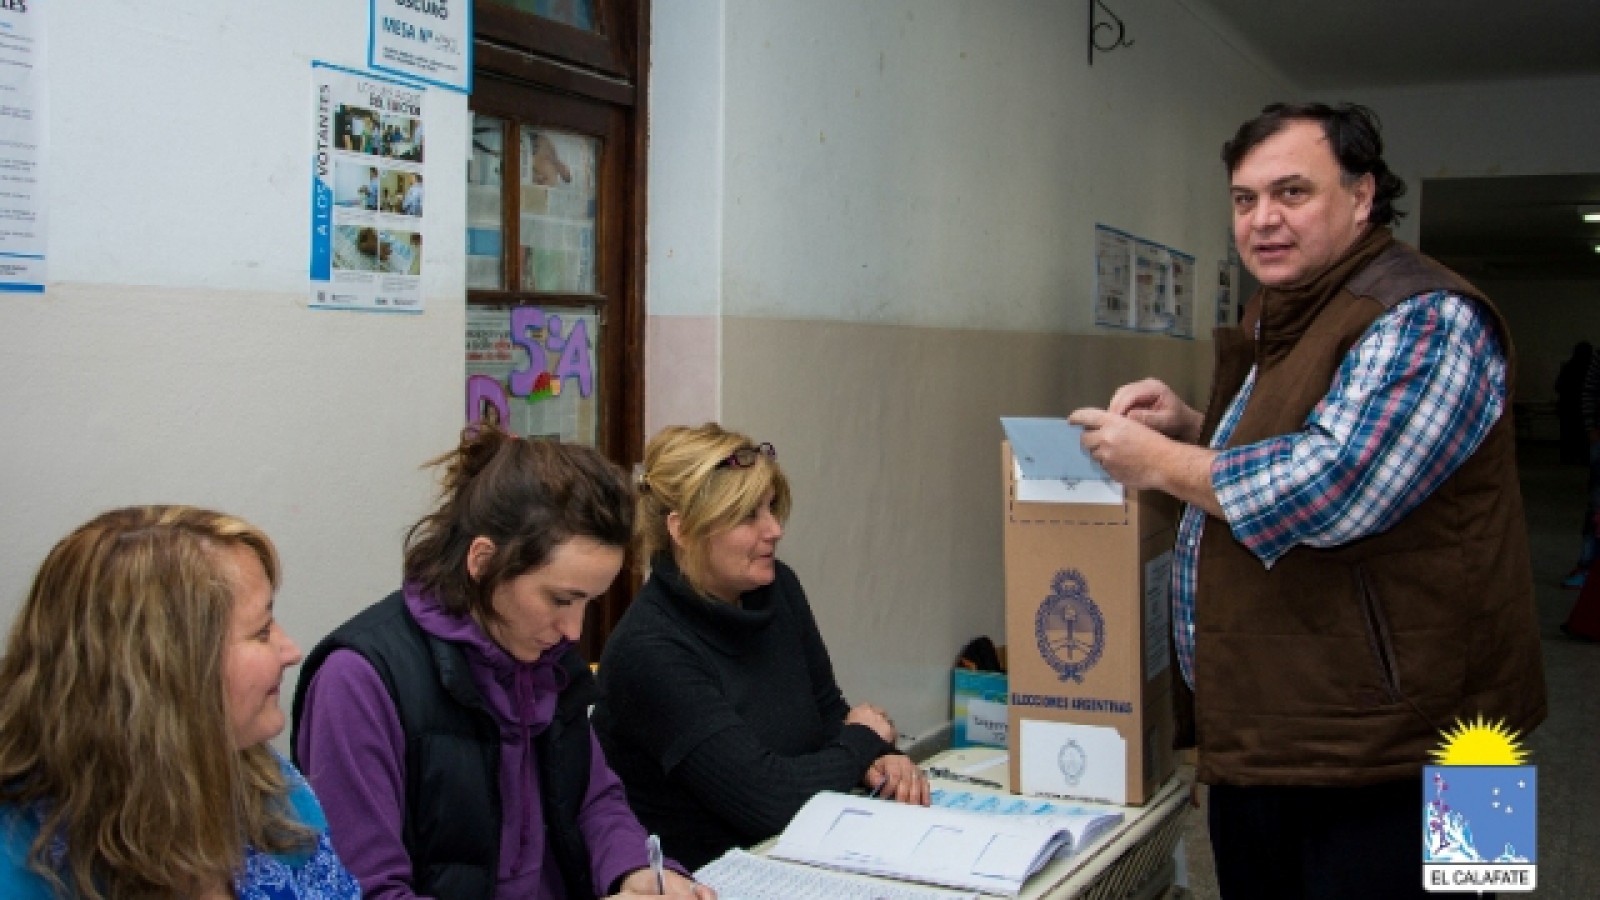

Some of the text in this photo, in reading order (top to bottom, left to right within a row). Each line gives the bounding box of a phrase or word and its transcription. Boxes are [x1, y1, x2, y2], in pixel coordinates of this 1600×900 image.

[382, 16, 416, 40] MESA
[317, 84, 330, 176] VOTANTES
[1011, 692, 1133, 714] ELECCIONES ARGENTINAS
